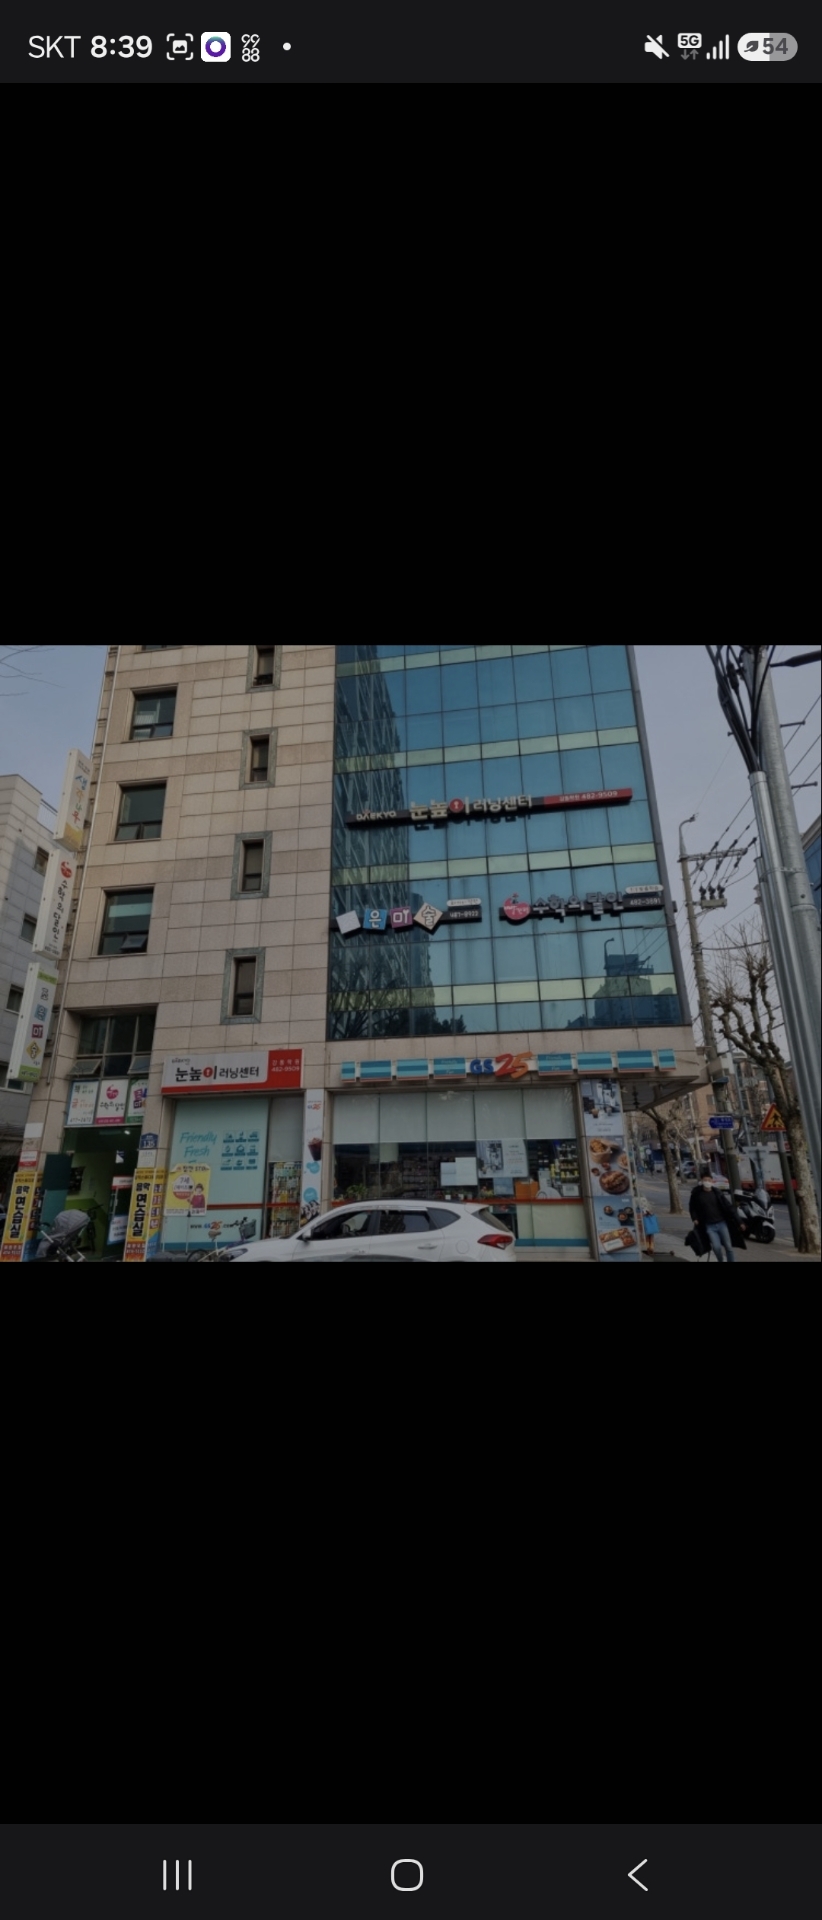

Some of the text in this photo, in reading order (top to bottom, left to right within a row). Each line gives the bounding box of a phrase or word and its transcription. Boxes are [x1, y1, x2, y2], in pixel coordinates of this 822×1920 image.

[356, 810, 397, 821] DAEKYO
[410, 796, 470, 821] 눈높이
[473, 795, 533, 813] 러닝센터
[581, 790, 618, 800] 482-9509
[175, 1066, 259, 1082] 눈높이 러닝센터
[179, 1131, 218, 1145] Friendly
[183, 1146, 211, 1158] Fresh
[132, 1194, 148, 1237] 연습실
